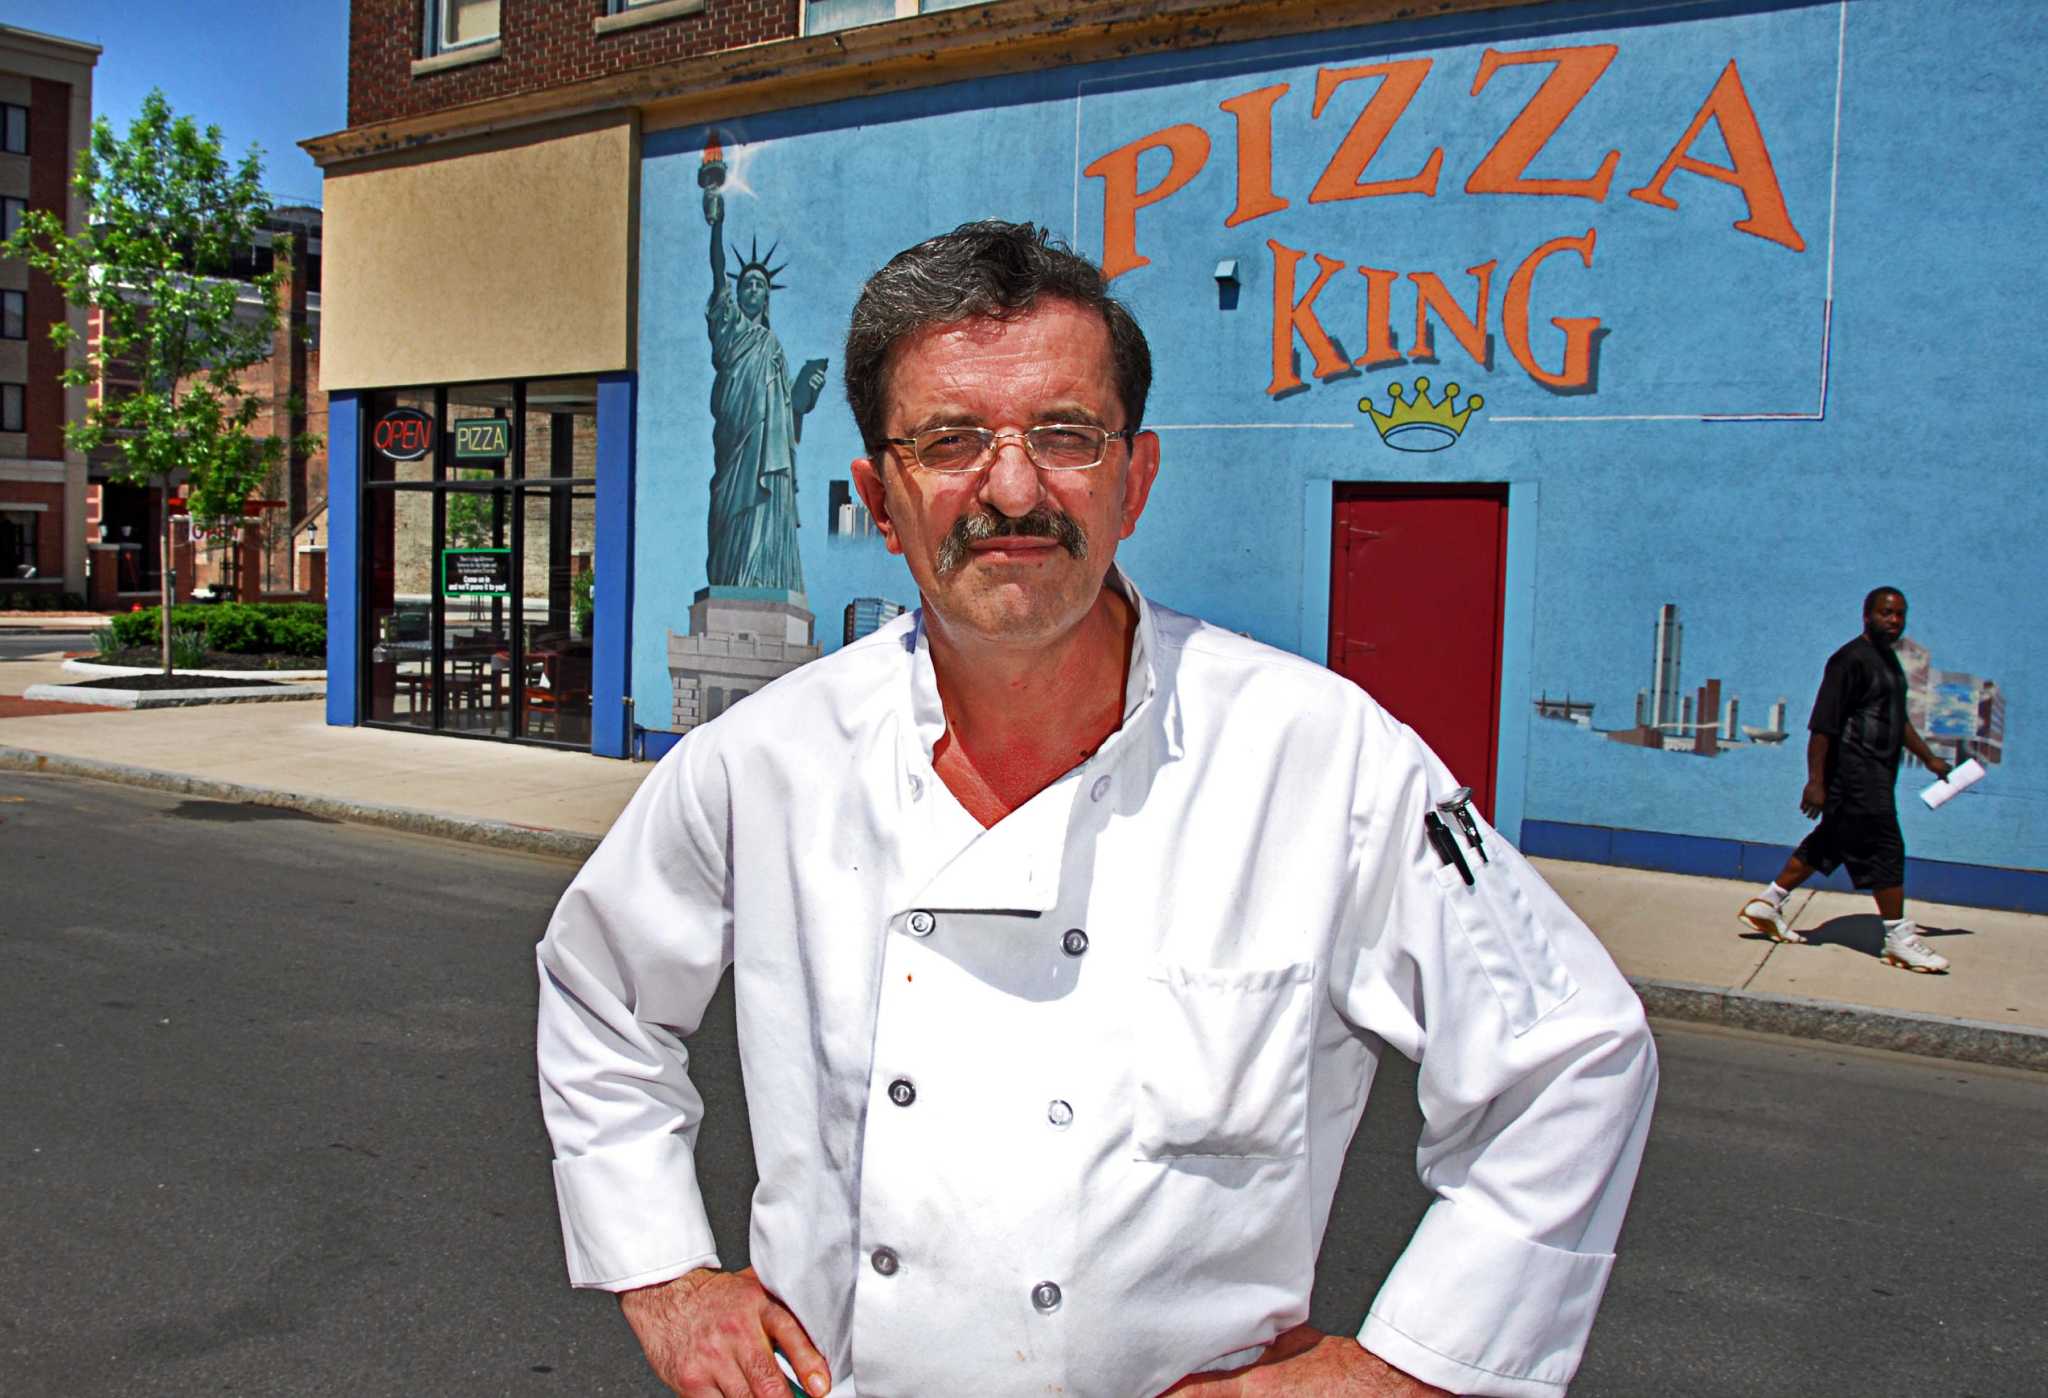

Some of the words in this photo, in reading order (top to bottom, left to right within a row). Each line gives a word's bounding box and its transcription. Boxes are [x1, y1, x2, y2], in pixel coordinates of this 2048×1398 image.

[1083, 44, 1806, 281] PIZZA
[1266, 228, 1602, 397] KING
[374, 418, 432, 450] OPEN
[457, 426, 505, 451] PIZZA
